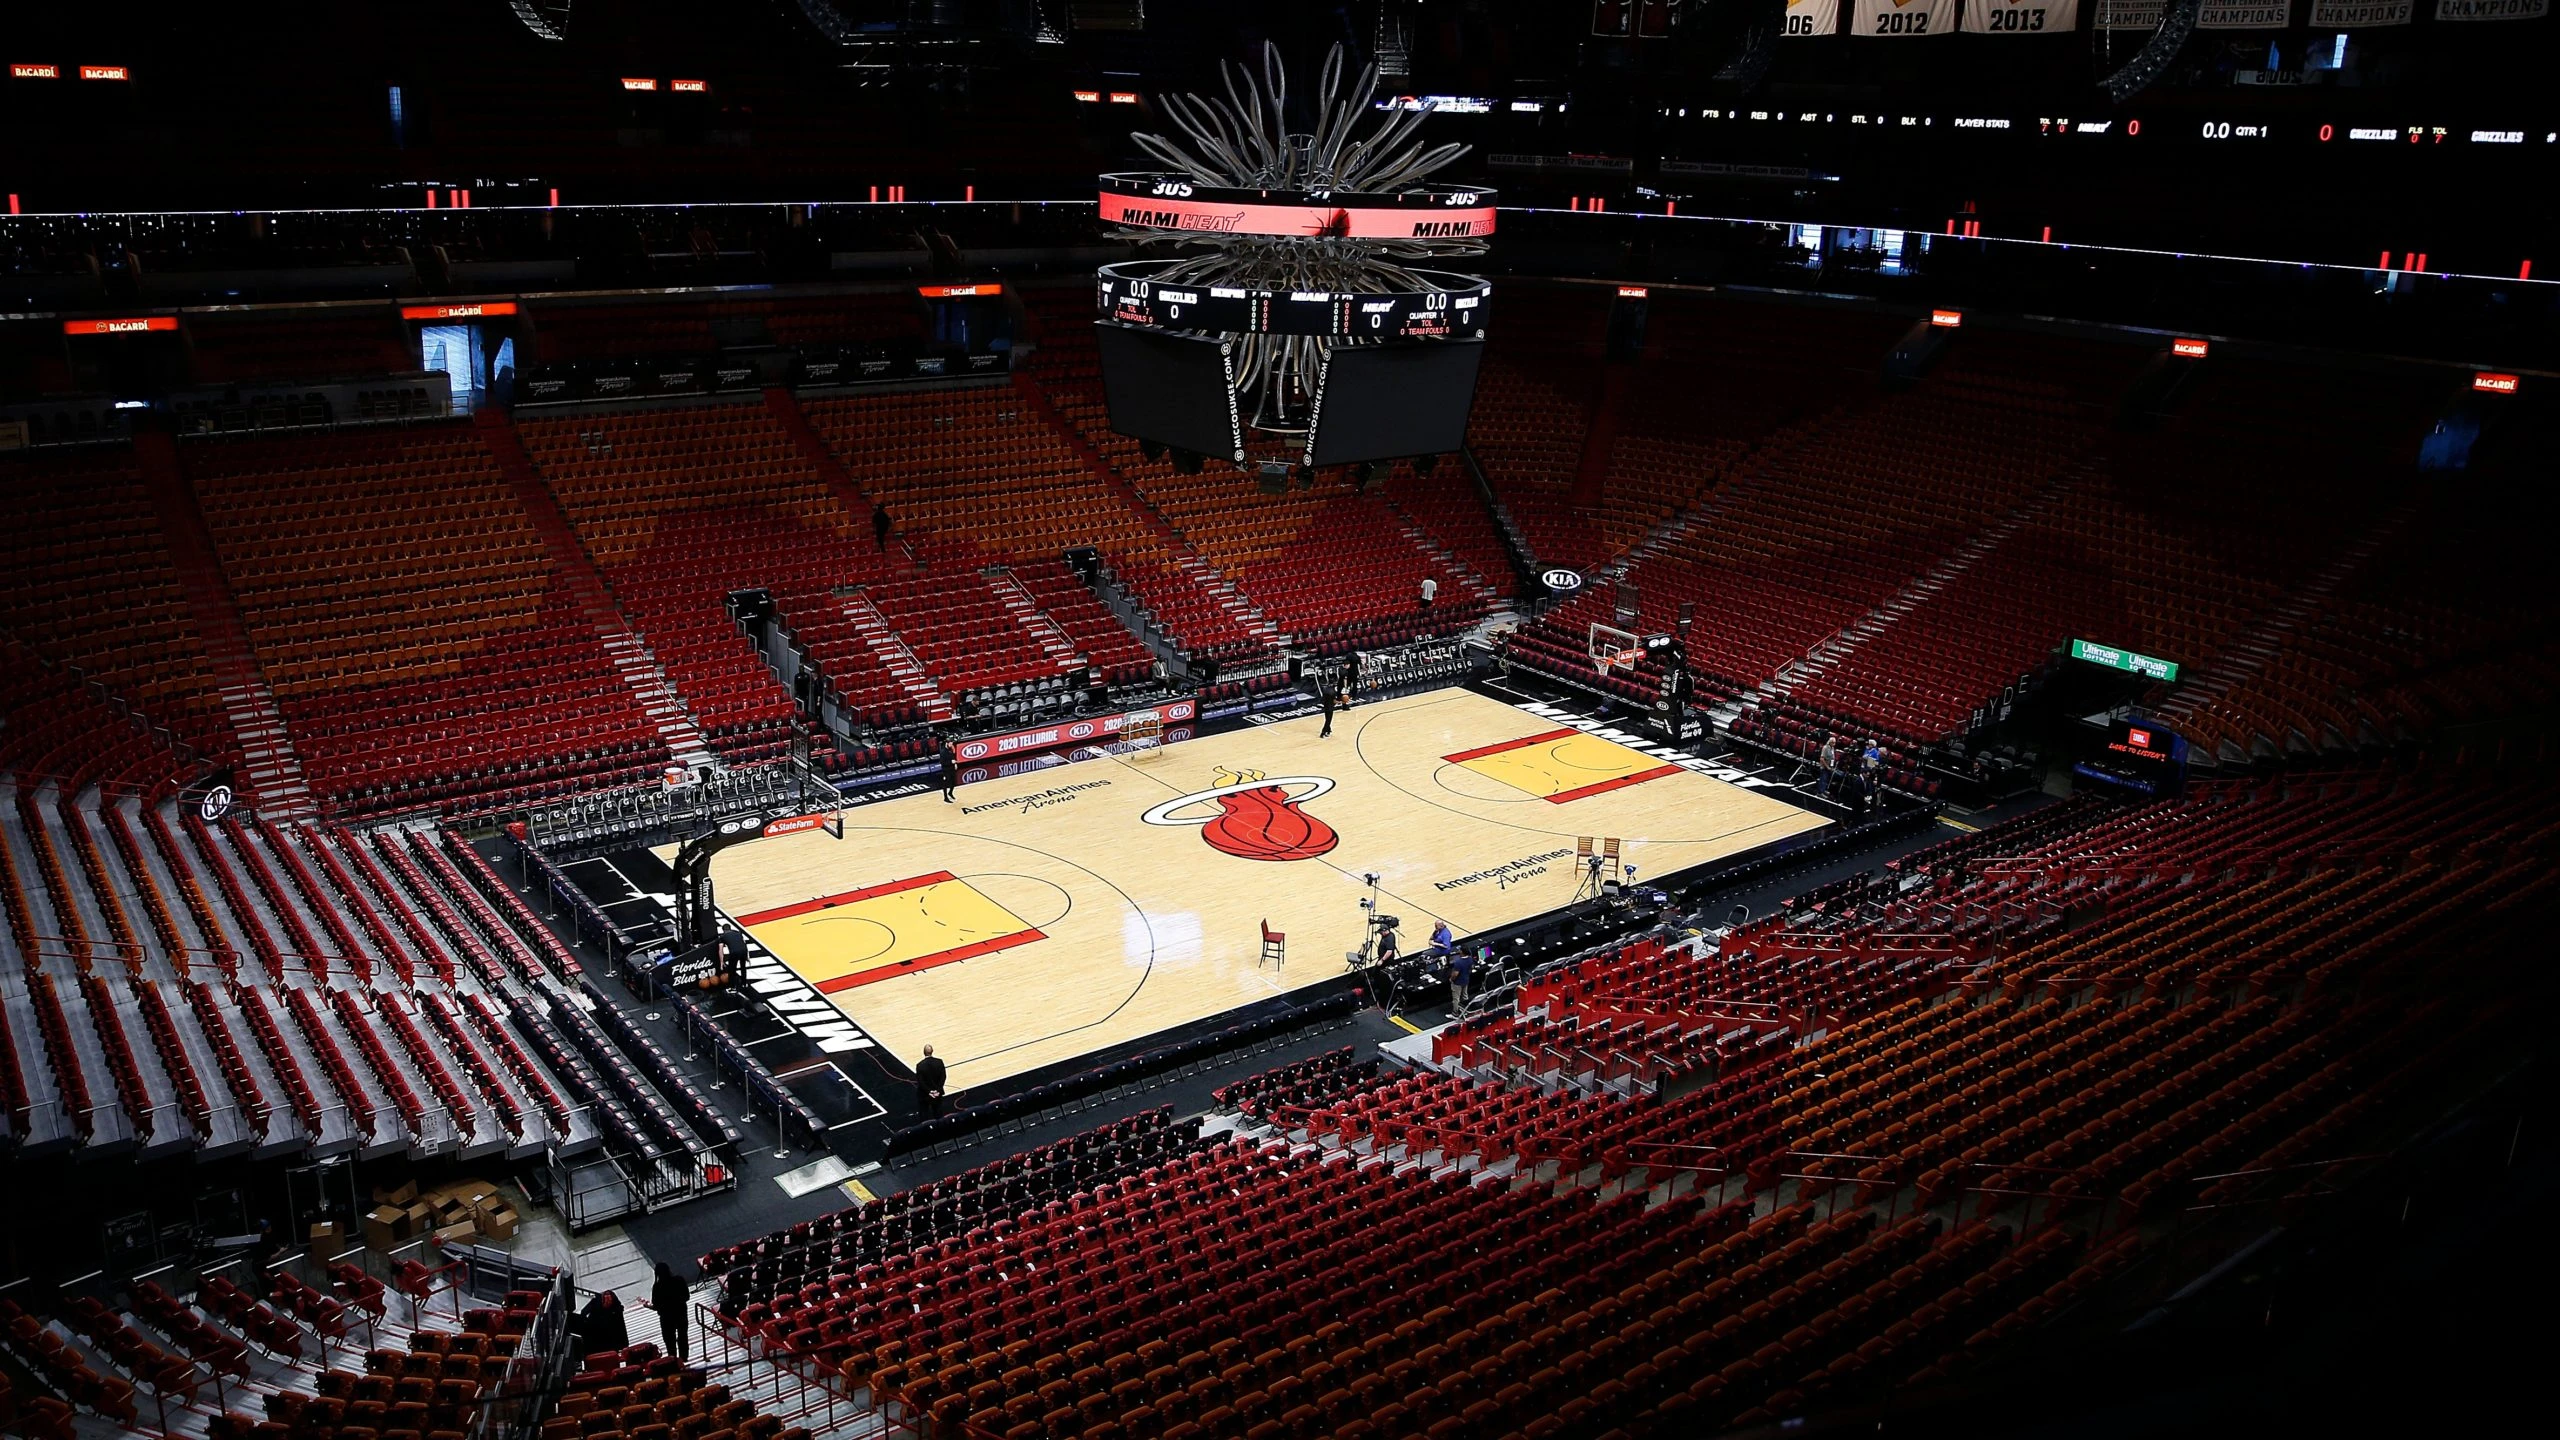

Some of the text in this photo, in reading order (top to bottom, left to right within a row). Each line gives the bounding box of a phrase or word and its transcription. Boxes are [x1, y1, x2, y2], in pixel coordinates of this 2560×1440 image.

[1990, 9, 2046, 31] 2013
[2201, 9, 2285, 23] CHAMPIONS
[2316, 6, 2408, 21] CHAMPIONS
[1781, 16, 1813, 35] 06
[1876, 13, 1928, 34] 2012
[15, 66, 55, 77] BACARDÍ
[85, 68, 126, 79] BACARDÍ
[1703, 109, 1736, 119] PTS 0
[1751, 111, 1784, 121] REB 0
[1801, 113, 1834, 123] AST 0
[1851, 115, 1884, 125] STL 0
[1901, 116, 1932, 126] BLK 0
[1955, 118, 2010, 129] PLAYER STATS
[2128, 120, 2139, 135] 0
[2202, 122, 2267, 138] 0.0 QTR 1
[2319, 125, 2332, 141] 0
[2350, 128, 2398, 140] GRIZZLIES
[2432, 127, 2447, 135] TOL
[2471, 131, 2524, 143] GRIZZLIES
[2411, 134, 2442, 143] 0 7
[1151, 182, 1193, 197] 305
[1122, 208, 1245, 231] MIAMI HEAT
[1412, 221, 1471, 237] MIAMI
[1130, 280, 1149, 298] 0.0
[1119, 297, 1140, 306] QUARTER
[1291, 292, 1330, 302] MIAMI
[1426, 293, 1447, 310] 0.0
[449, 304, 483, 317] BACARDÍ
[1170, 305, 1179, 319] 0
[1362, 300, 1395, 313] HEAT
[1371, 314, 1381, 328] 0
[1409, 312, 1437, 320] QUARTER
[1462, 311, 1468, 324] 0
[109, 319, 150, 333] BACARDÍ
[1408, 327, 1425, 336] TEAM
[1425, 327, 1443, 335] FOULS
[2475, 378, 2516, 390] BACARDÍ
[1223, 356, 1242, 448] MICCOSUKEE.COM
[1306, 362, 1328, 453] MICCOSUKEE.COM
[1549, 572, 1575, 586] KIA
[2082, 643, 2120, 660] Ultimate
[2082, 652, 2117, 666] SOFTWARE
[2128, 654, 2167, 672] Ultimate
[1171, 706, 1189, 717] KIA
[1072, 725, 1092, 737] KIA
[998, 729, 1058, 752] 2020 TELLURIDE
[1517, 702, 1795, 789] MIAMI HEAT
[964, 745, 985, 757] KIA
[872, 781, 931, 800] Health
[961, 779, 1112, 815] AmericanAirlines
[1020, 794, 1076, 814] Arena
[778, 819, 814, 832] StateFarm
[1434, 848, 1574, 891] AmericanAirlines
[1496, 866, 1548, 890] Arena
[702, 877, 711, 910] Ultimate
[671, 957, 714, 974] Florida
[672, 972, 697, 988] Blue
